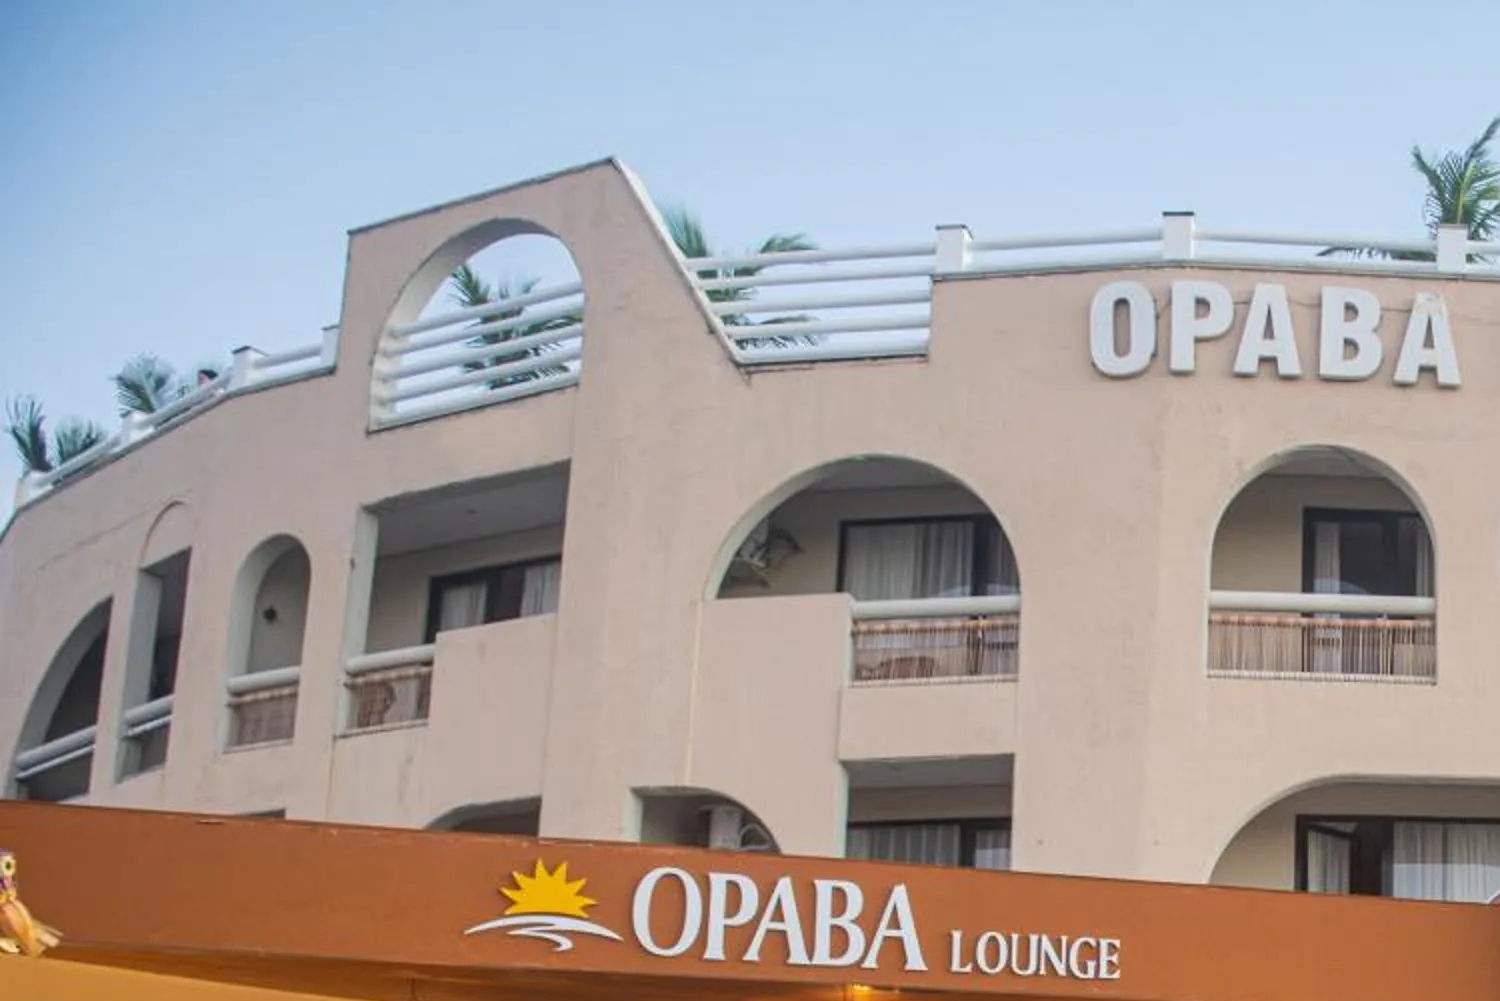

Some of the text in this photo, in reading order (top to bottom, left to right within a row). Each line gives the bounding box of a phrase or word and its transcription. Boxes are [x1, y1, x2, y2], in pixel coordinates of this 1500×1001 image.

[1087, 280, 1462, 388] OPABA
[631, 866, 1122, 979] OPABA LOUNGE
